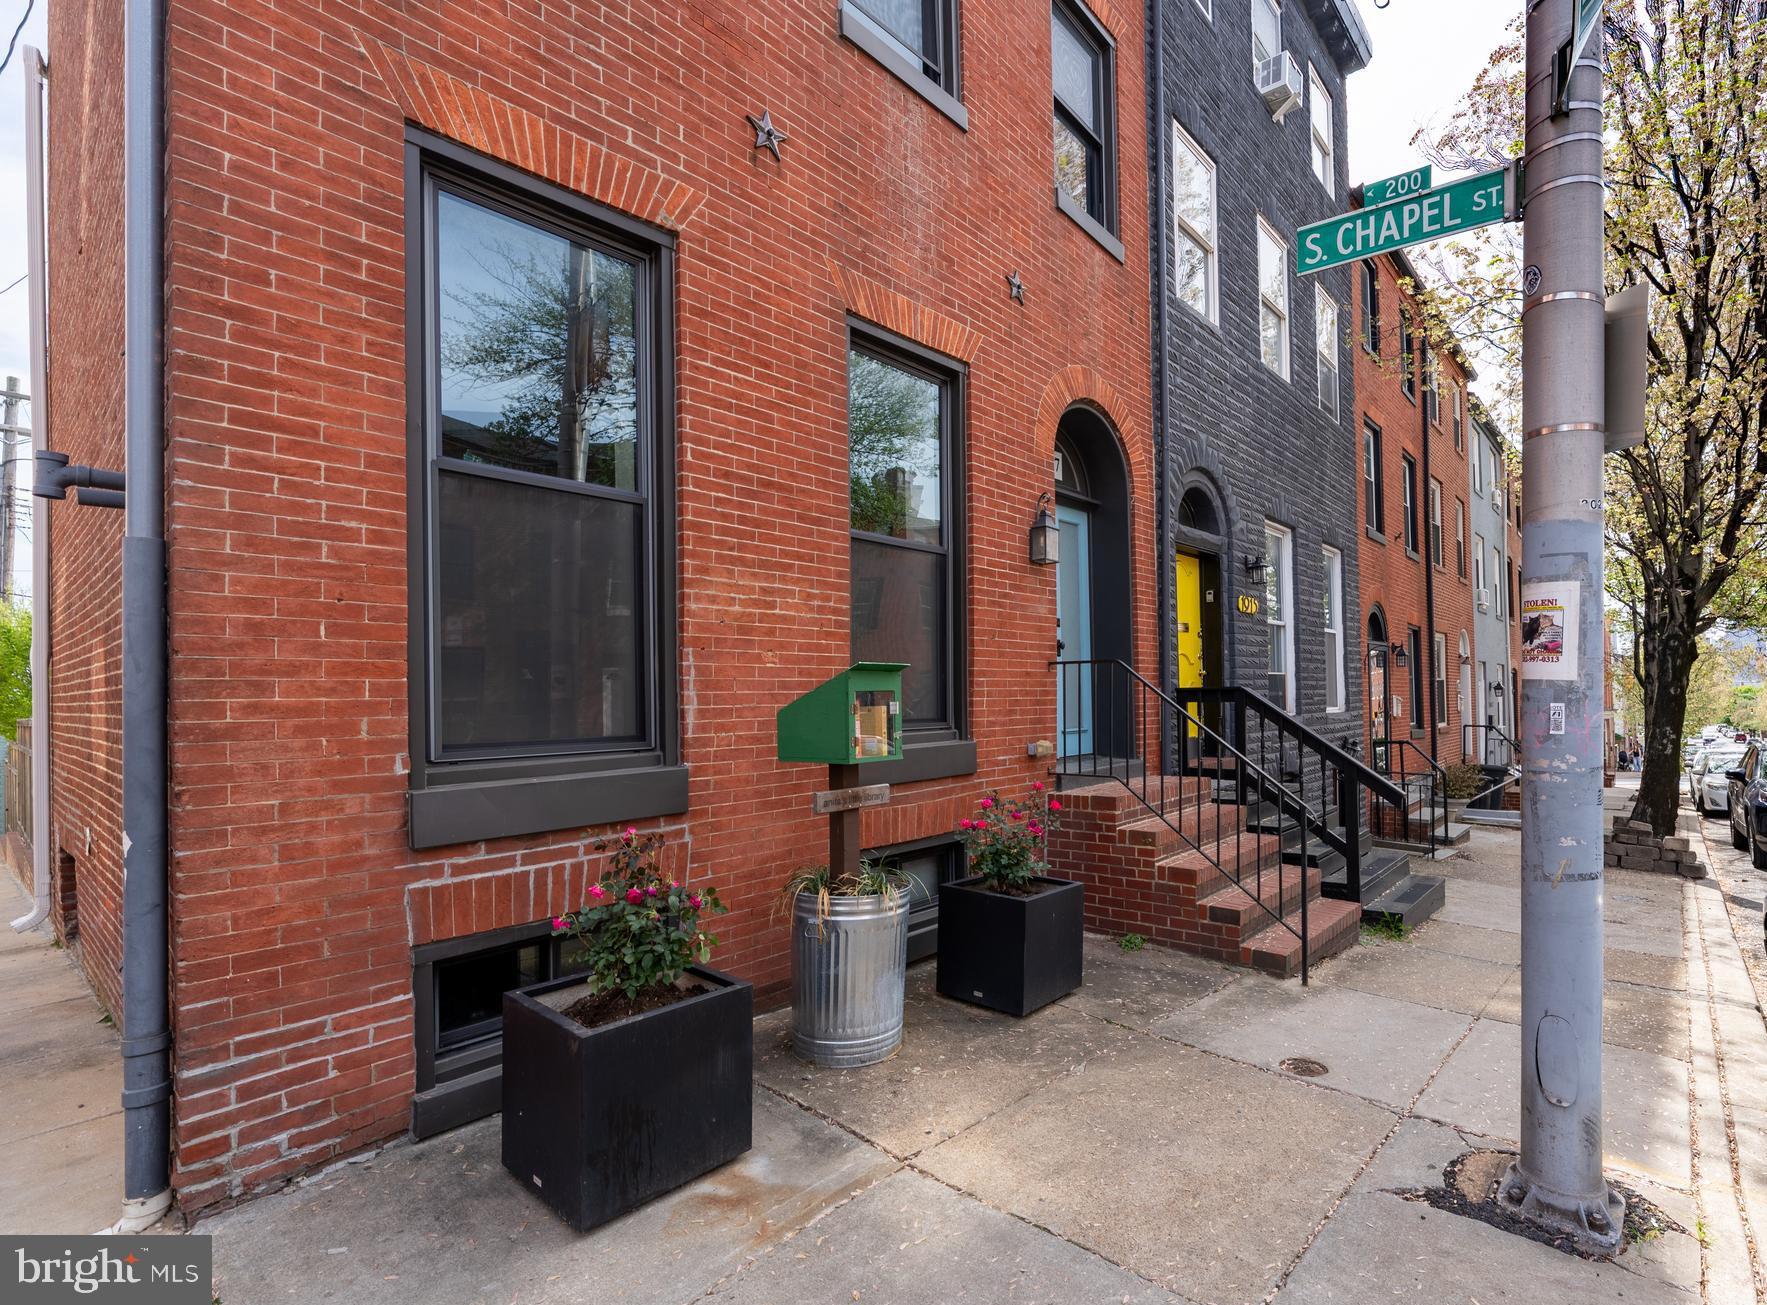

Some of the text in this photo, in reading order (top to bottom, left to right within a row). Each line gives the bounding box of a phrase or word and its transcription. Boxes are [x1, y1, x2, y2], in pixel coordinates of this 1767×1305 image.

[1386, 172, 1422, 199] 200
[1305, 186, 1503, 264] S. CHAPEL ST.
[1239, 596, 1258, 614] 1915
